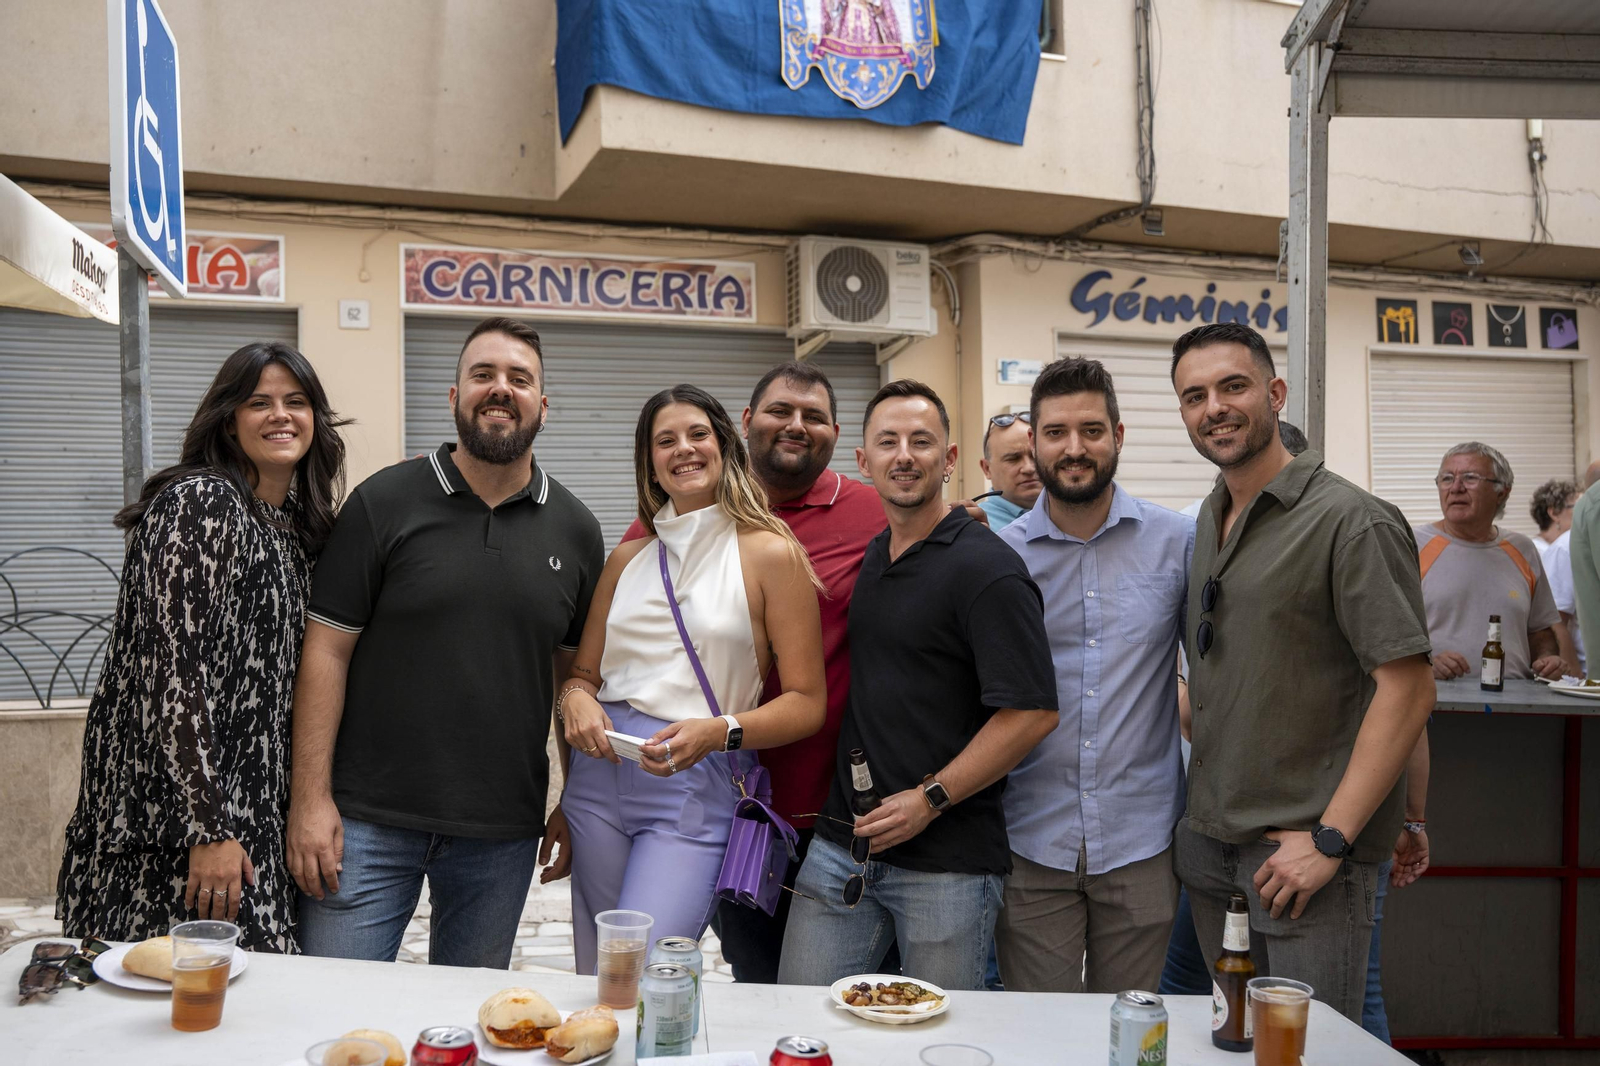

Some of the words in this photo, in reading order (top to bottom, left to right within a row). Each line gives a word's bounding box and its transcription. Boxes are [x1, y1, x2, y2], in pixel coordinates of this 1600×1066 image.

[896, 249, 921, 262] beko
[422, 258, 747, 311] CARNICERIA
[347, 307, 361, 321] 62
